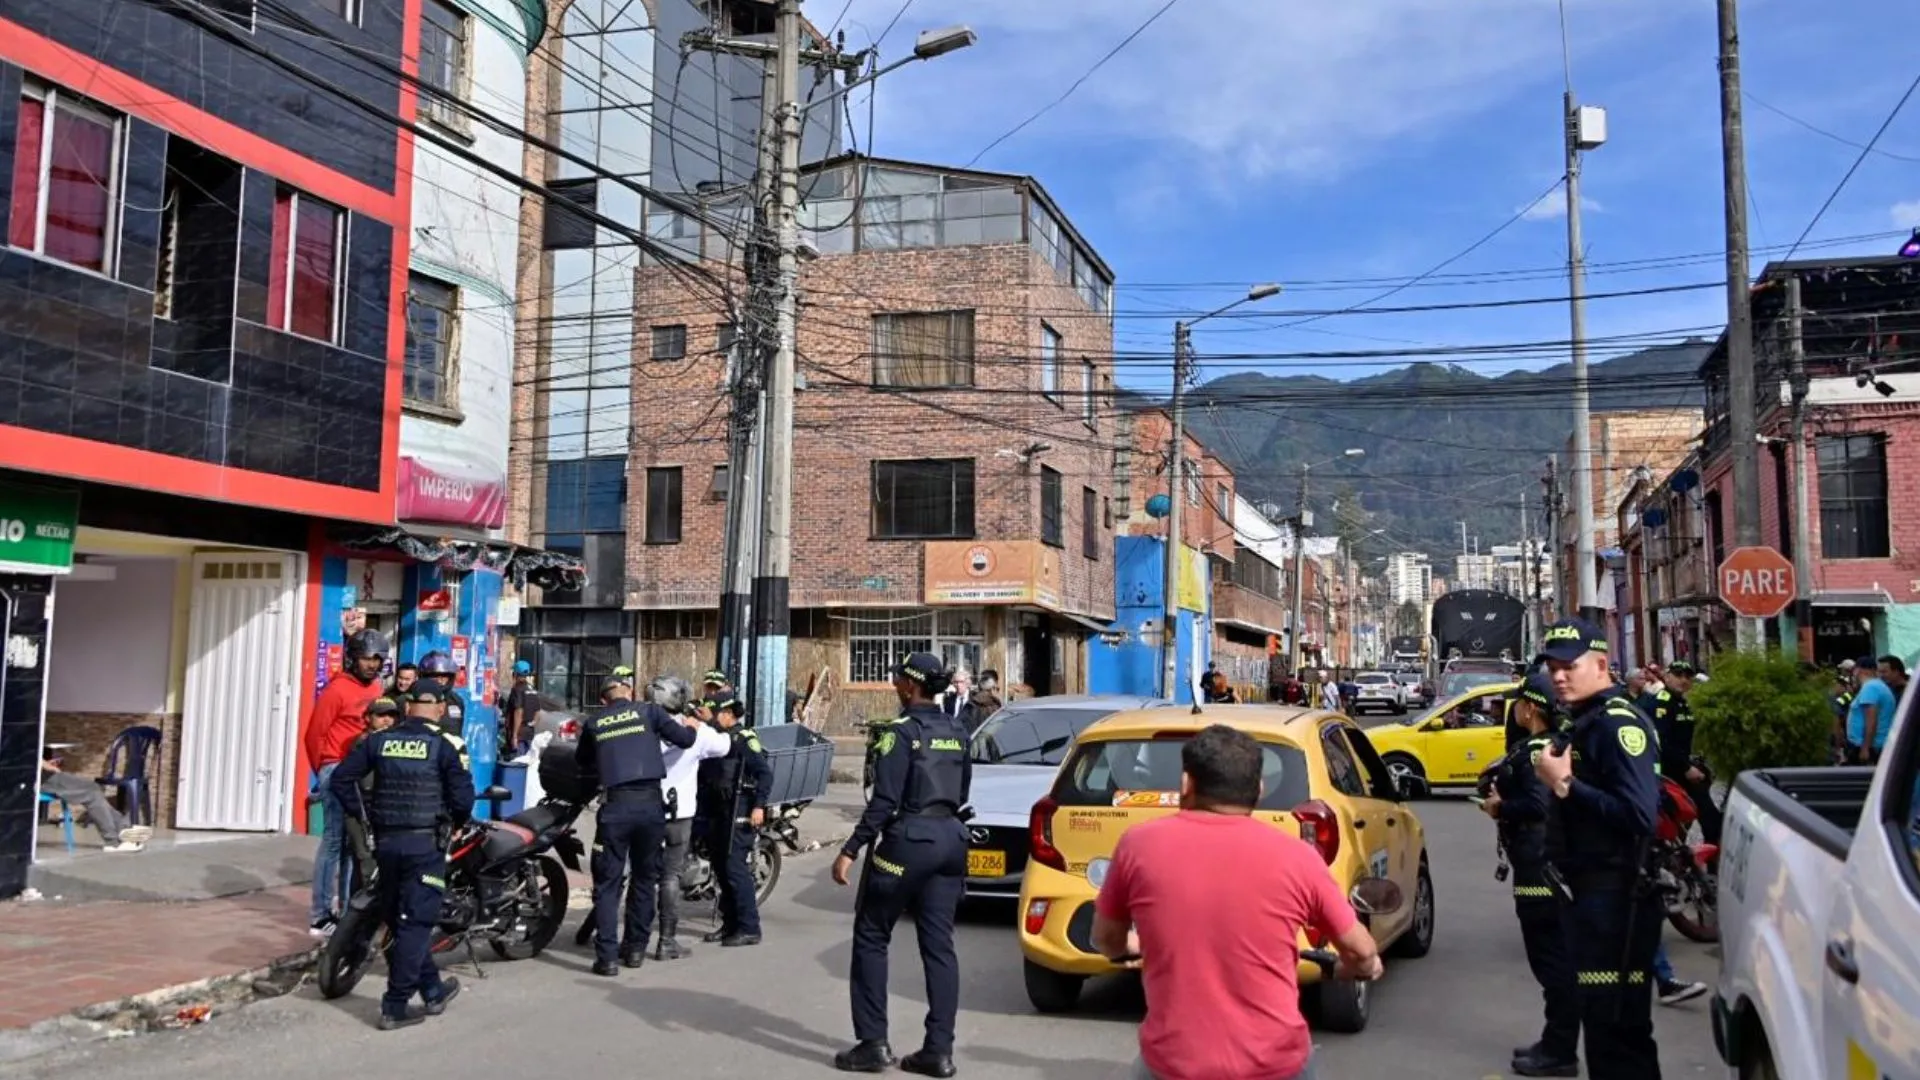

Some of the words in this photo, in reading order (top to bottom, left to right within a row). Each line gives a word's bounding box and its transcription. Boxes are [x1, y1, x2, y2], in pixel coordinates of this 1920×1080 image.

[419, 476, 473, 503] IMPERIO
[35, 524, 70, 539] NECTAR
[1725, 568, 1789, 595] PARE
[597, 710, 639, 727] POLICÍA
[383, 739, 427, 754] POLICÍA
[930, 738, 961, 749] POLICÍA
[982, 855, 1002, 869] 286
